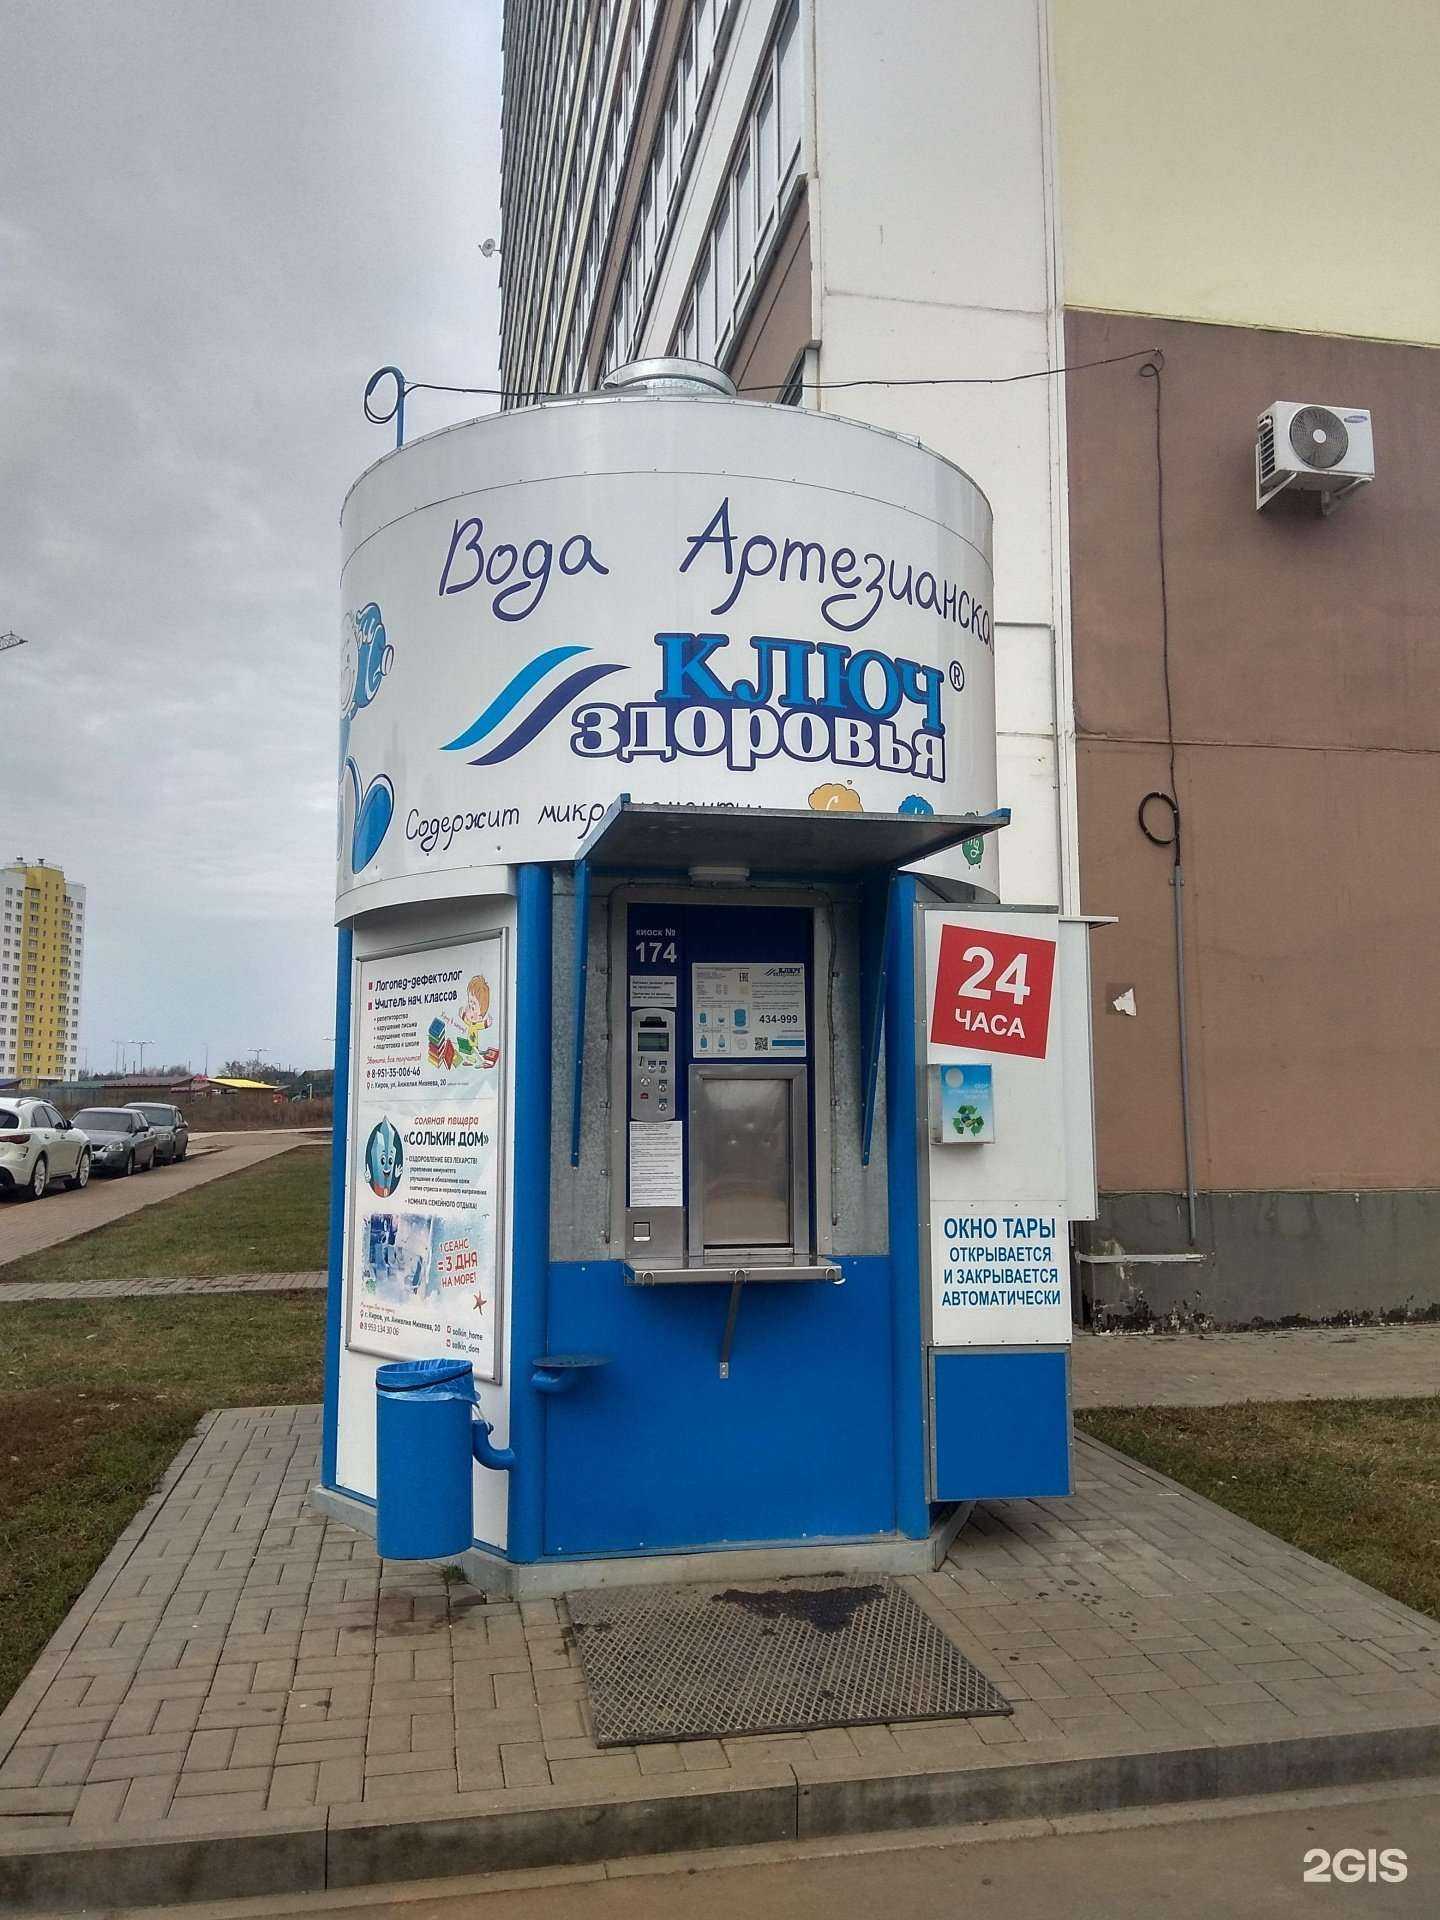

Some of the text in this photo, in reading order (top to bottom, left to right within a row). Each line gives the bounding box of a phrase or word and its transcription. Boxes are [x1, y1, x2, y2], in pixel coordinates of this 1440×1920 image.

[438, 517, 609, 622] Вода
[654, 633, 945, 735] КЛЮЧ
[570, 702, 946, 783] здоровья
[405, 807, 520, 853] Содержит
[635, 942, 677, 963] 174
[374, 969, 463, 992] Логопед-дефектолог
[958, 946, 1031, 1005] 24
[374, 996, 407, 1010] Учитель
[424, 989, 458, 1004] классов
[759, 1014, 798, 1024] 434-999
[954, 1008, 1026, 1039] ЧАСА
[414, 1116, 479, 1131] соляная пещера
[404, 1131, 489, 1147] «СОЛЬКИН ДОМ»
[944, 1218, 1056, 1239] ОКНО ТАРЫ
[444, 1239, 469, 1253] СЕАНС
[949, 1247, 1051, 1262] ОТКРЫВАЕТСЯ
[446, 1255, 453, 1272] 3
[455, 1251, 478, 1271] ДНЯ
[442, 1277, 453, 1288] НА
[944, 1268, 1058, 1284] И ЗАКРЫВАЕТСЯ
[941, 1290, 1061, 1306] АВТОМАТИЧЕСКИ
